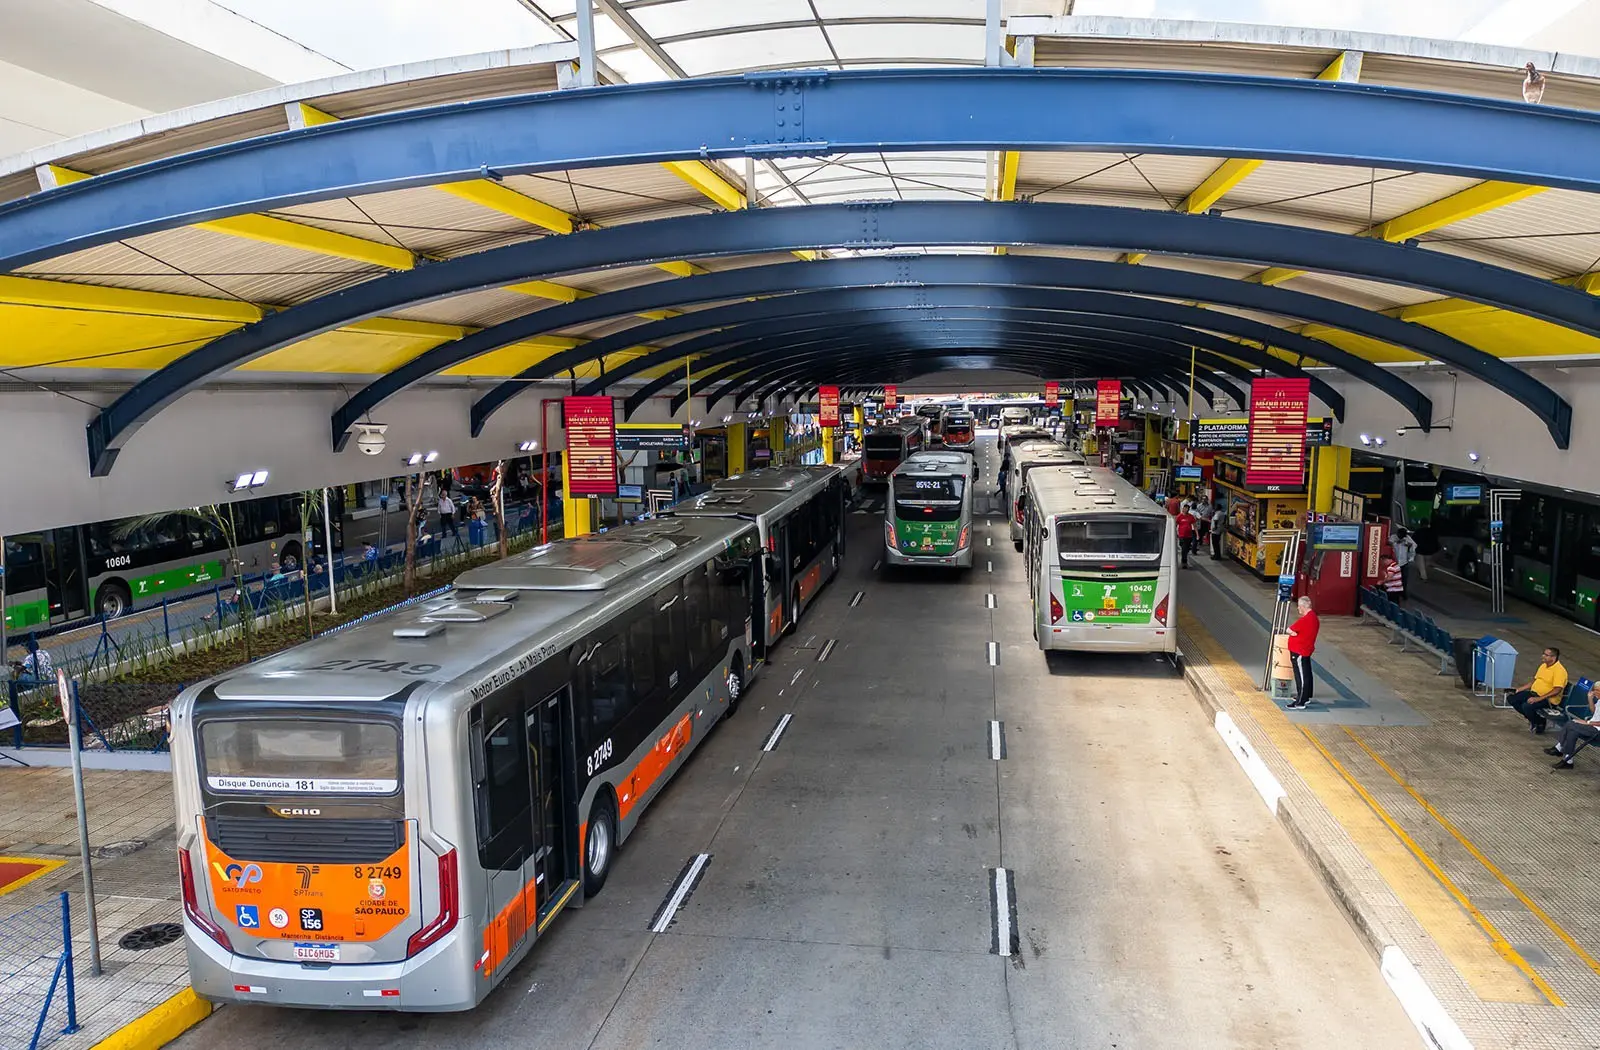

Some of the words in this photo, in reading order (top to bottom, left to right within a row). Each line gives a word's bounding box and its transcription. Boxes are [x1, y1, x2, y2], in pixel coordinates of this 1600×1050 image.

[1370, 529, 1380, 575] Banco24Horas
[105, 554, 131, 569] 10604
[308, 659, 442, 675] 2749
[471, 681, 492, 702] Motor
[491, 671, 510, 688] Euro
[509, 665, 516, 678] 5
[519, 659, 527, 672] Ar
[526, 650, 541, 668] Mais
[540, 644, 556, 658] Puro
[587, 755, 593, 777] 8
[594, 737, 613, 771] 2749
[218, 779, 246, 791] Disque
[250, 779, 290, 791] Denúncia
[295, 780, 315, 790] 181
[354, 866, 363, 879] 8
[367, 866, 402, 880] 2749
[294, 888, 324, 897] SPTrans
[301, 909, 316, 919] SP
[375, 907, 406, 915] PAULO
[274, 914, 283, 922] 50
[302, 919, 322, 929] 156
[281, 932, 311, 940] Mantenha
[297, 948, 336, 959] GIC6H05
